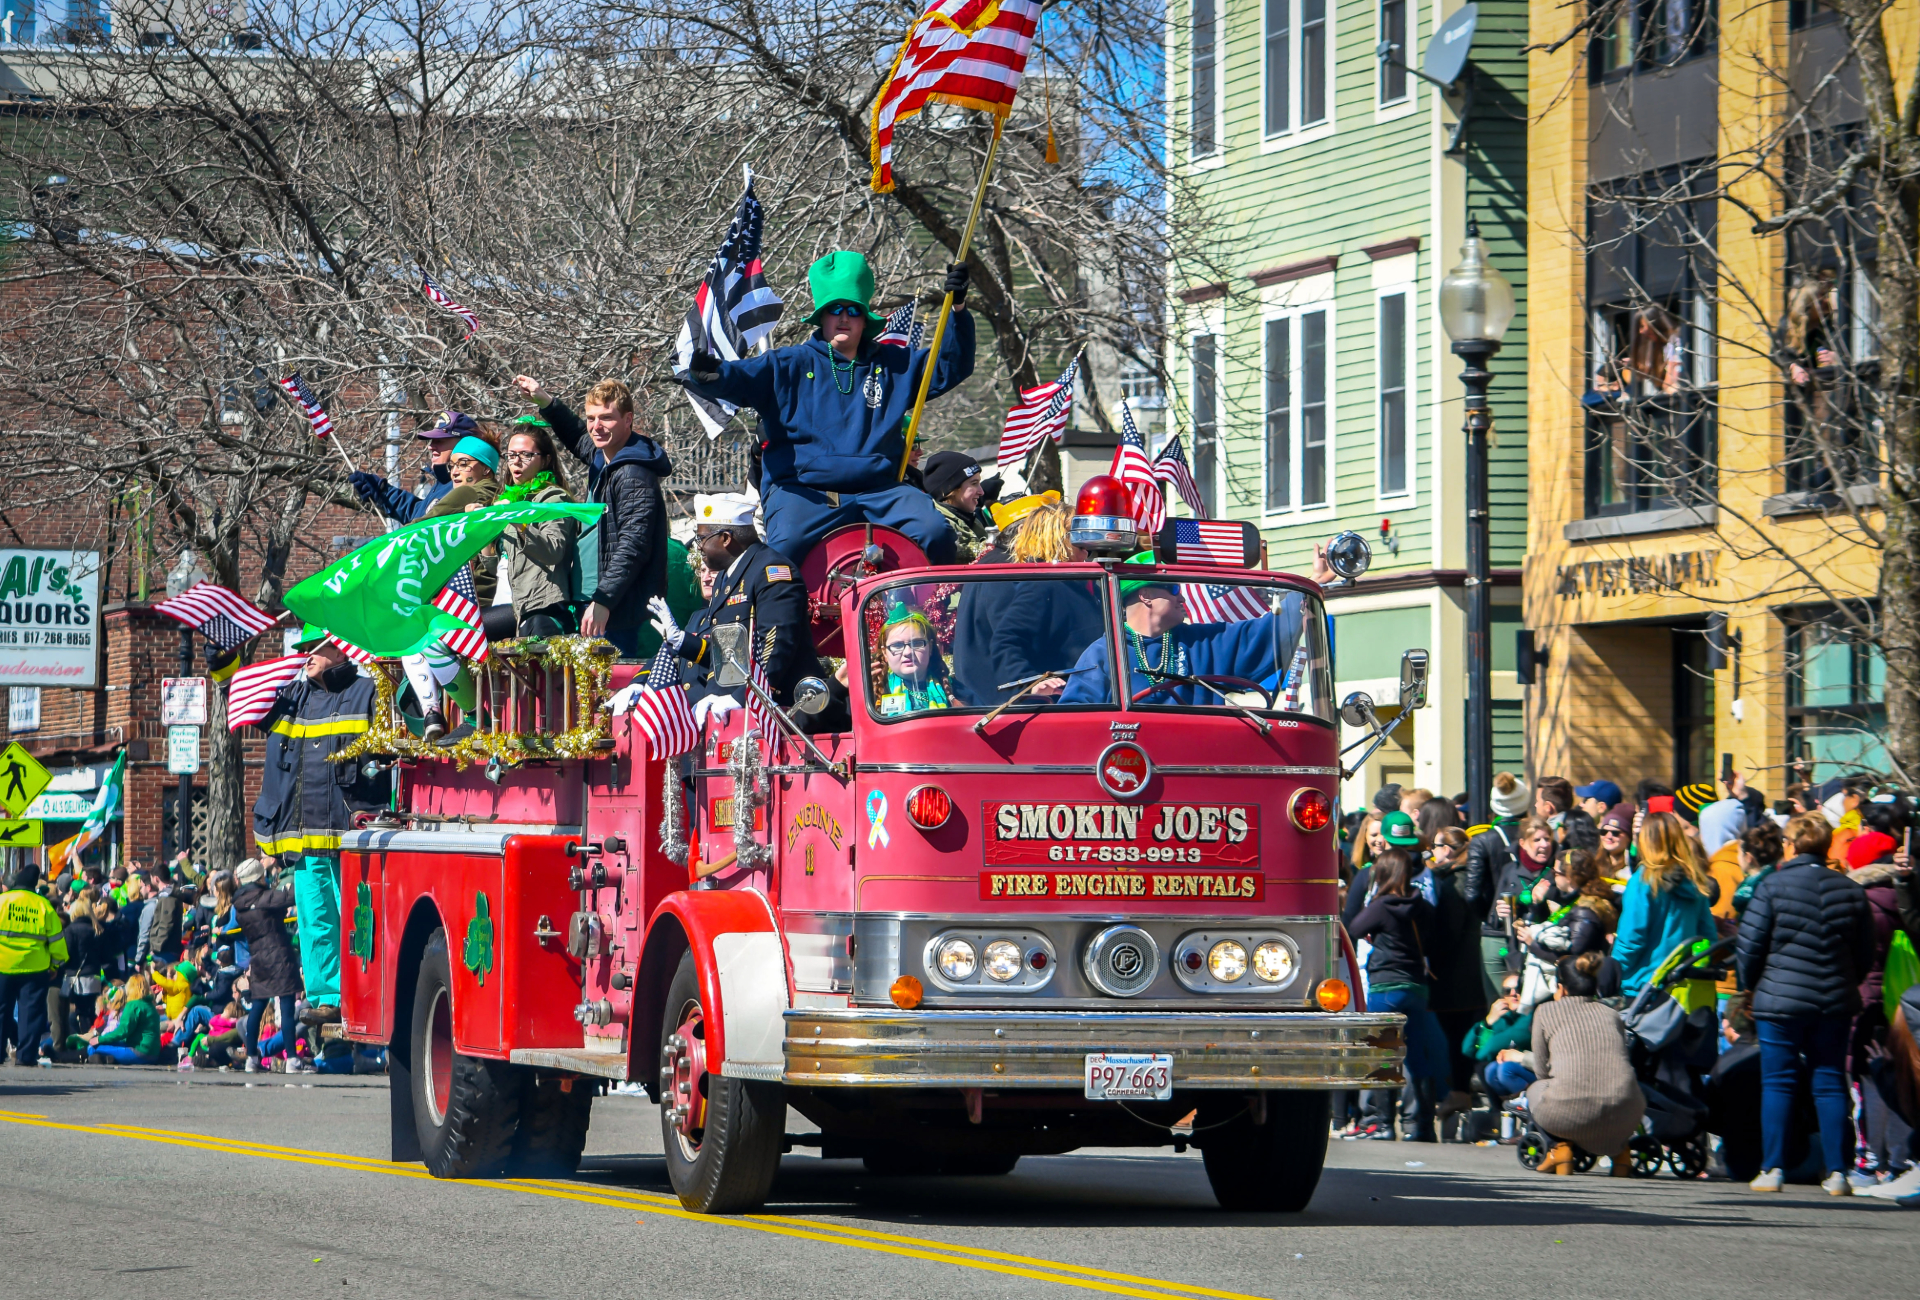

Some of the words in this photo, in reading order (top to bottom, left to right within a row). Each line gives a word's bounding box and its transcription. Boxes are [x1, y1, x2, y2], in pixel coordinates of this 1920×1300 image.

[0, 555, 69, 601] Al's
[1107, 753, 1140, 767] Mack
[787, 802, 844, 853] ENGINE
[997, 804, 1144, 840] SMOKIN'
[1154, 806, 1248, 842] JOE'S
[1049, 846, 1201, 863] 617-833-9913
[991, 874, 1048, 896] FIRE
[1055, 874, 1145, 896] ENGINE
[1152, 876, 1255, 898] RENTALS
[1105, 1056, 1153, 1064] Massachusetts
[1107, 1088, 1149, 1096] COMMERCIAL
